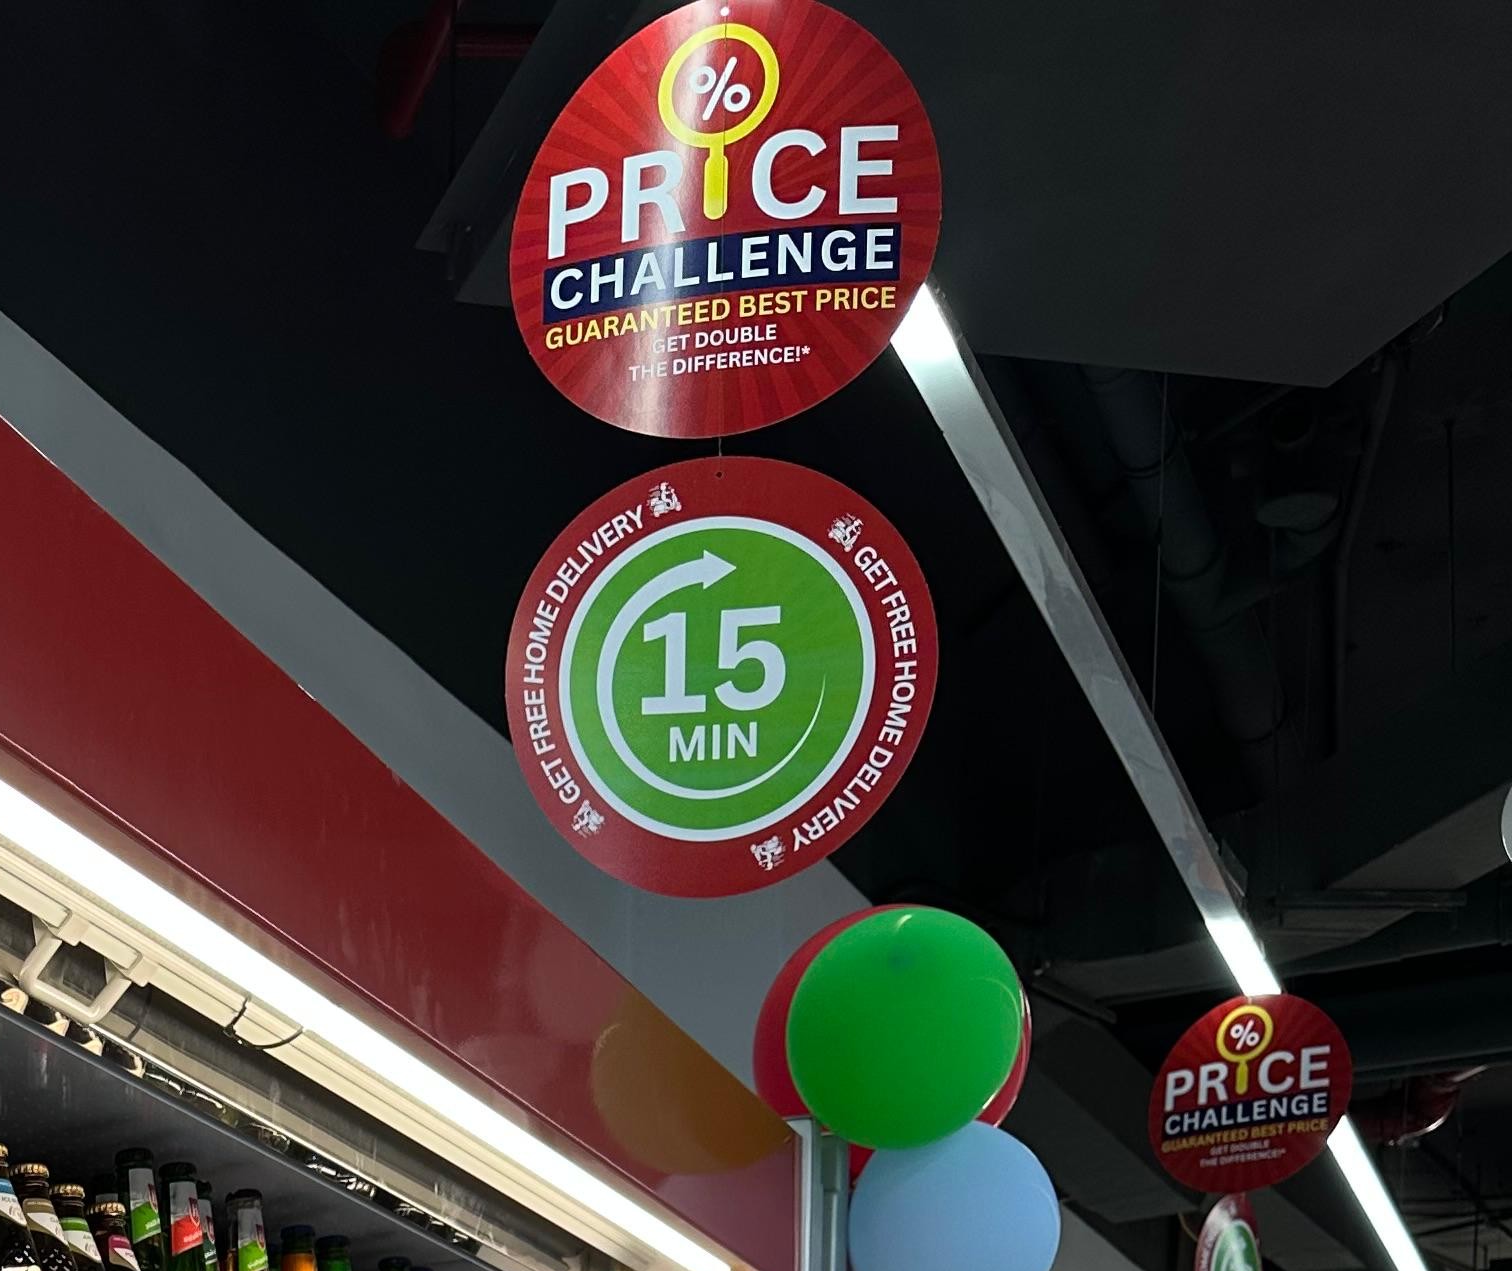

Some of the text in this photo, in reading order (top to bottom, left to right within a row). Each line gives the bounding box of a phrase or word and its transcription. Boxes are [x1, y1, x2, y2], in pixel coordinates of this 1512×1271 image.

[546, 125, 900, 260] PRICE
[550, 228, 895, 310] CHALLENGE
[545, 286, 896, 350] GUARANTEED BEST PRICE
[652, 324, 778, 355] GET DOUBLE
[629, 361, 667, 382] THE
[522, 504, 645, 805] GET FREE HOME DELIVERY
[641, 605, 786, 716] 15
[791, 546, 918, 853] GET FREE HOME DELIVERY
[669, 721, 758, 763] MIN
[1164, 1045, 1331, 1112] PRICE
[1161, 1118, 1329, 1153] GUARANTEED BEST PRICE
[1165, 1092, 1327, 1136] CHALLENGE
